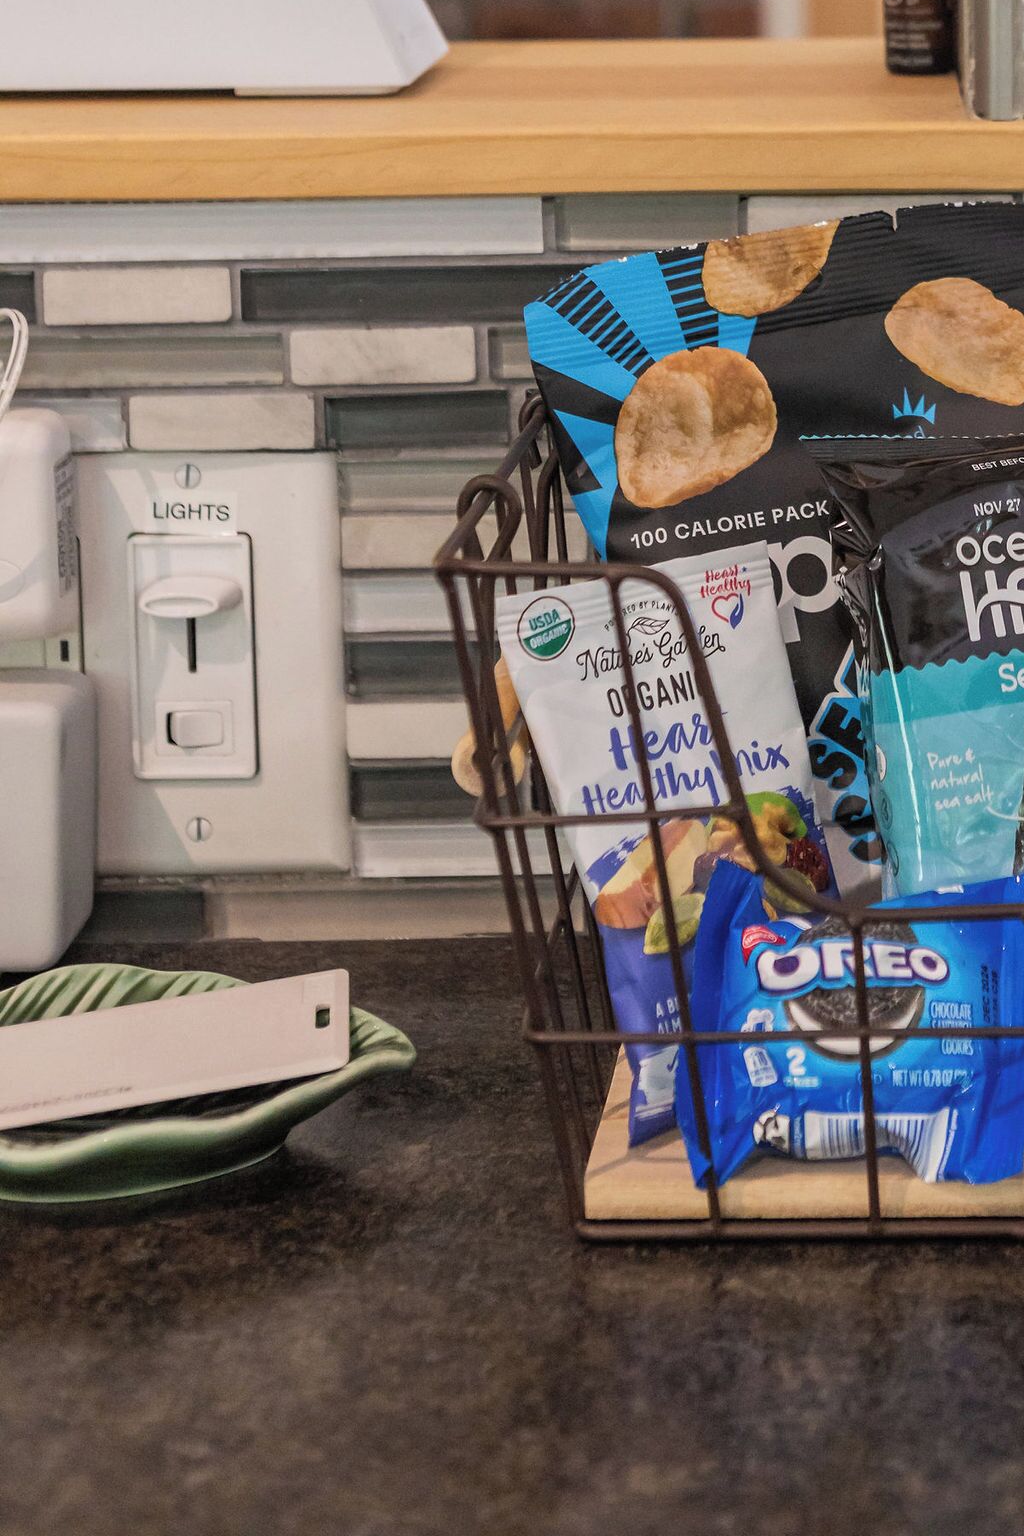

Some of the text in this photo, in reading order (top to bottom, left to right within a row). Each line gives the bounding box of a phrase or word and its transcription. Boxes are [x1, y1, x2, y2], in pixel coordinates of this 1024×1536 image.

[971, 460, 998, 472] BEST
[152, 501, 230, 522] LIGHTS
[973, 500, 1002, 517] NOV
[1006, 498, 1021, 513] 27
[630, 499, 830, 549] 100 CALORIE PACK
[704, 564, 738, 584] Heart
[700, 576, 751, 598] Healthy
[639, 600, 648, 610] BY
[528, 608, 561, 631] USDA
[530, 623, 570, 649] ORGANIC
[608, 712, 729, 771] Hear
[926, 752, 962, 771] Pure
[931, 763, 984, 790] natural
[934, 783, 994, 811] sea salt
[757, 942, 949, 992] OREO
[656, 1001, 664, 1019] A
[930, 1001, 972, 1021] CHOCOLATE
[786, 1046, 806, 1077] 2
[892, 1069, 908, 1087] NET
[908, 1069, 922, 1087] WT
[923, 1069, 941, 1088] 0.78
